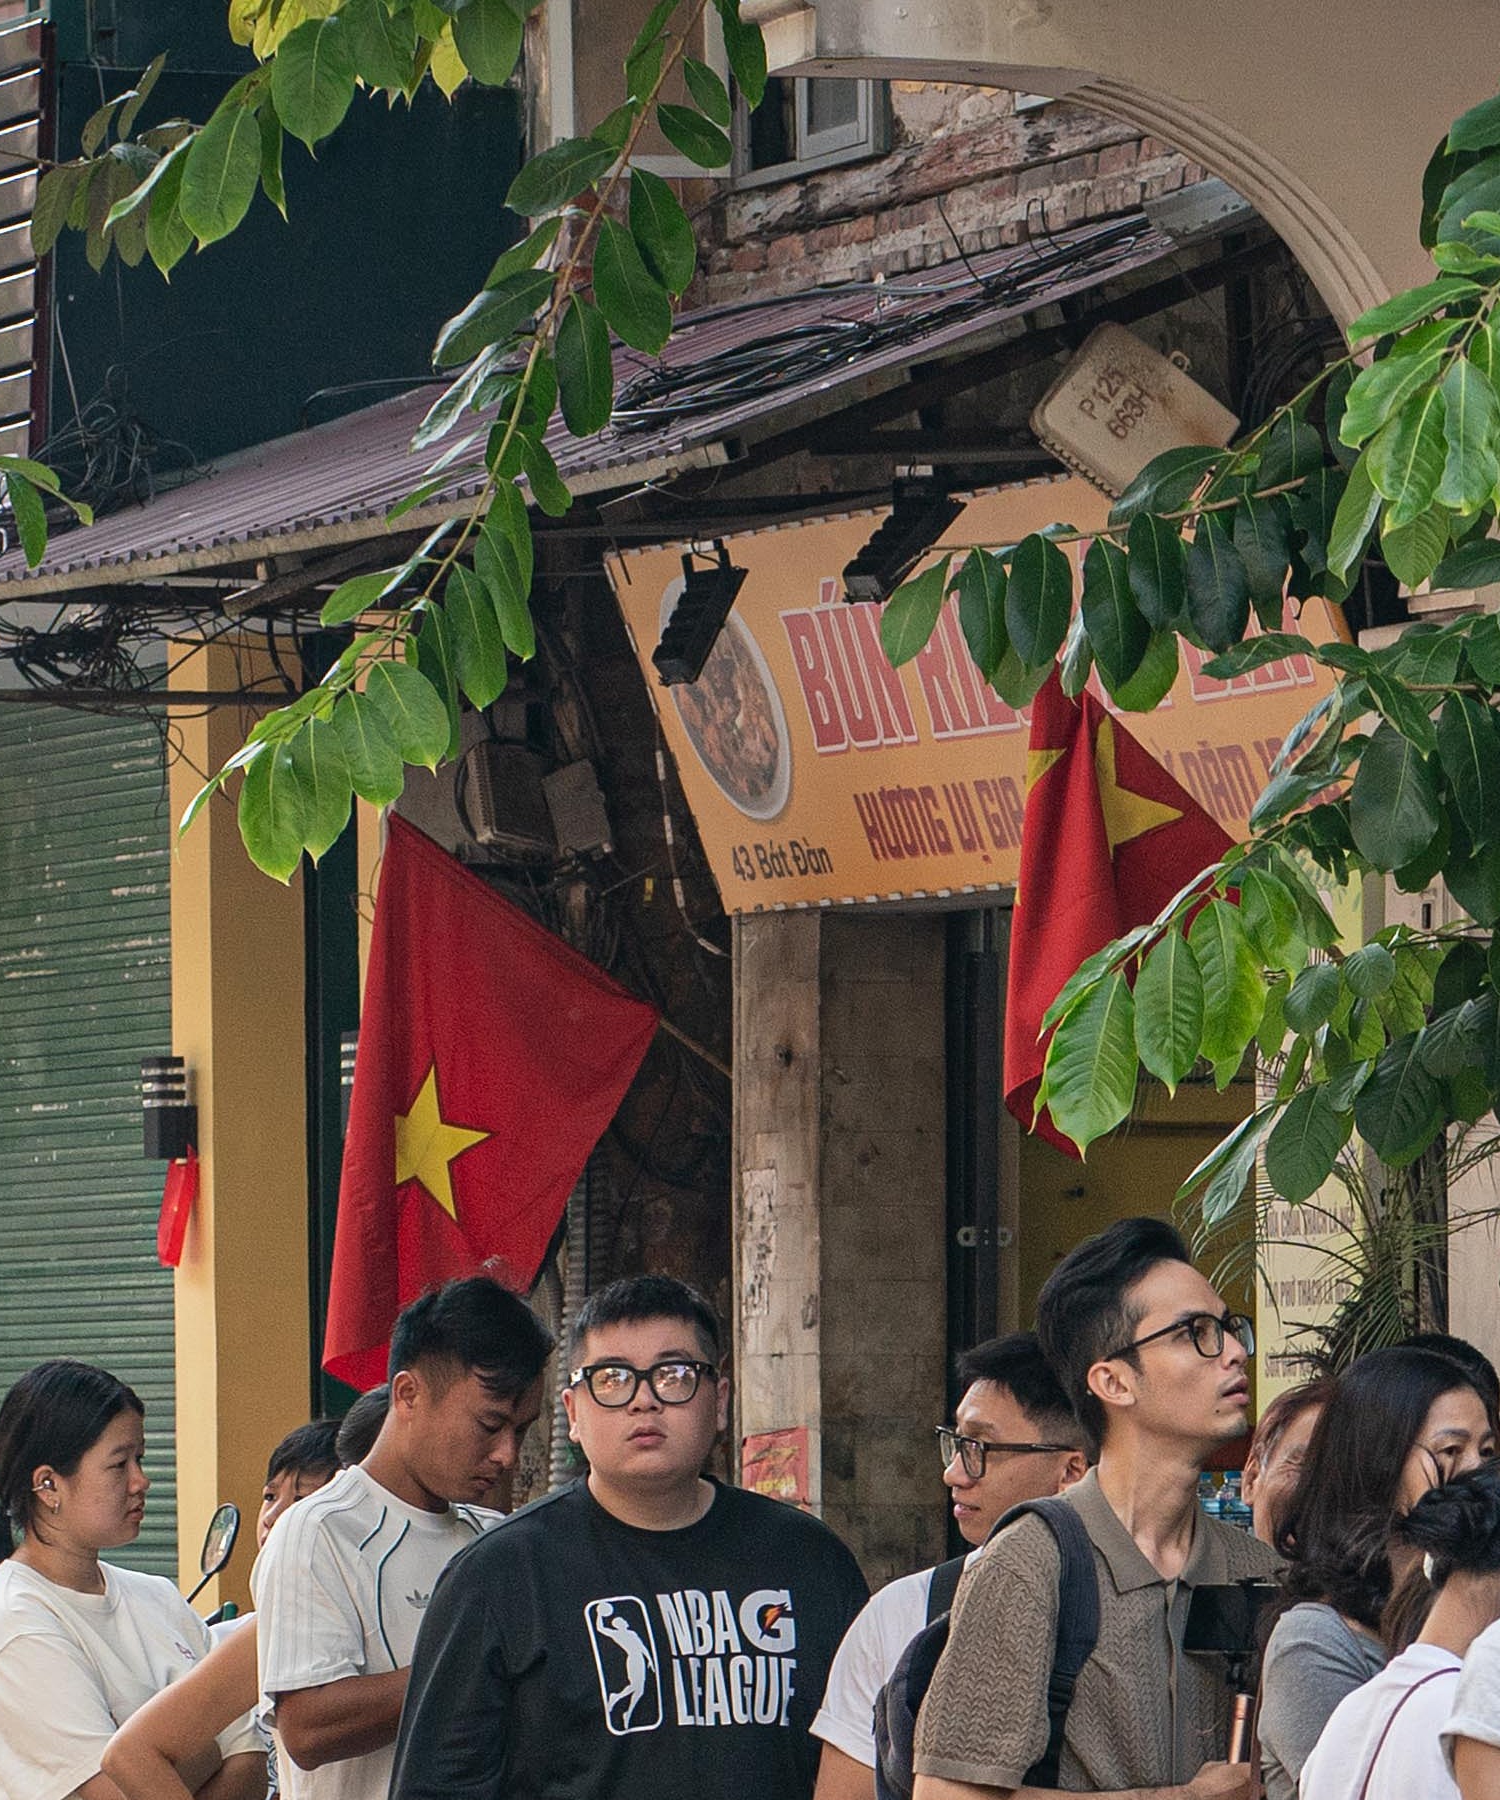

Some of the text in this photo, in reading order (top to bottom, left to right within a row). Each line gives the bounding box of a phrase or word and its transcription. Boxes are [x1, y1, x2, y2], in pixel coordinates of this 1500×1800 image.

[779, 577, 919, 754] BÚN
[731, 836, 834, 882] 43 Bát Đàn
[656, 1589, 797, 1656] NBA G
[672, 1654, 797, 1727] LEAGUE
